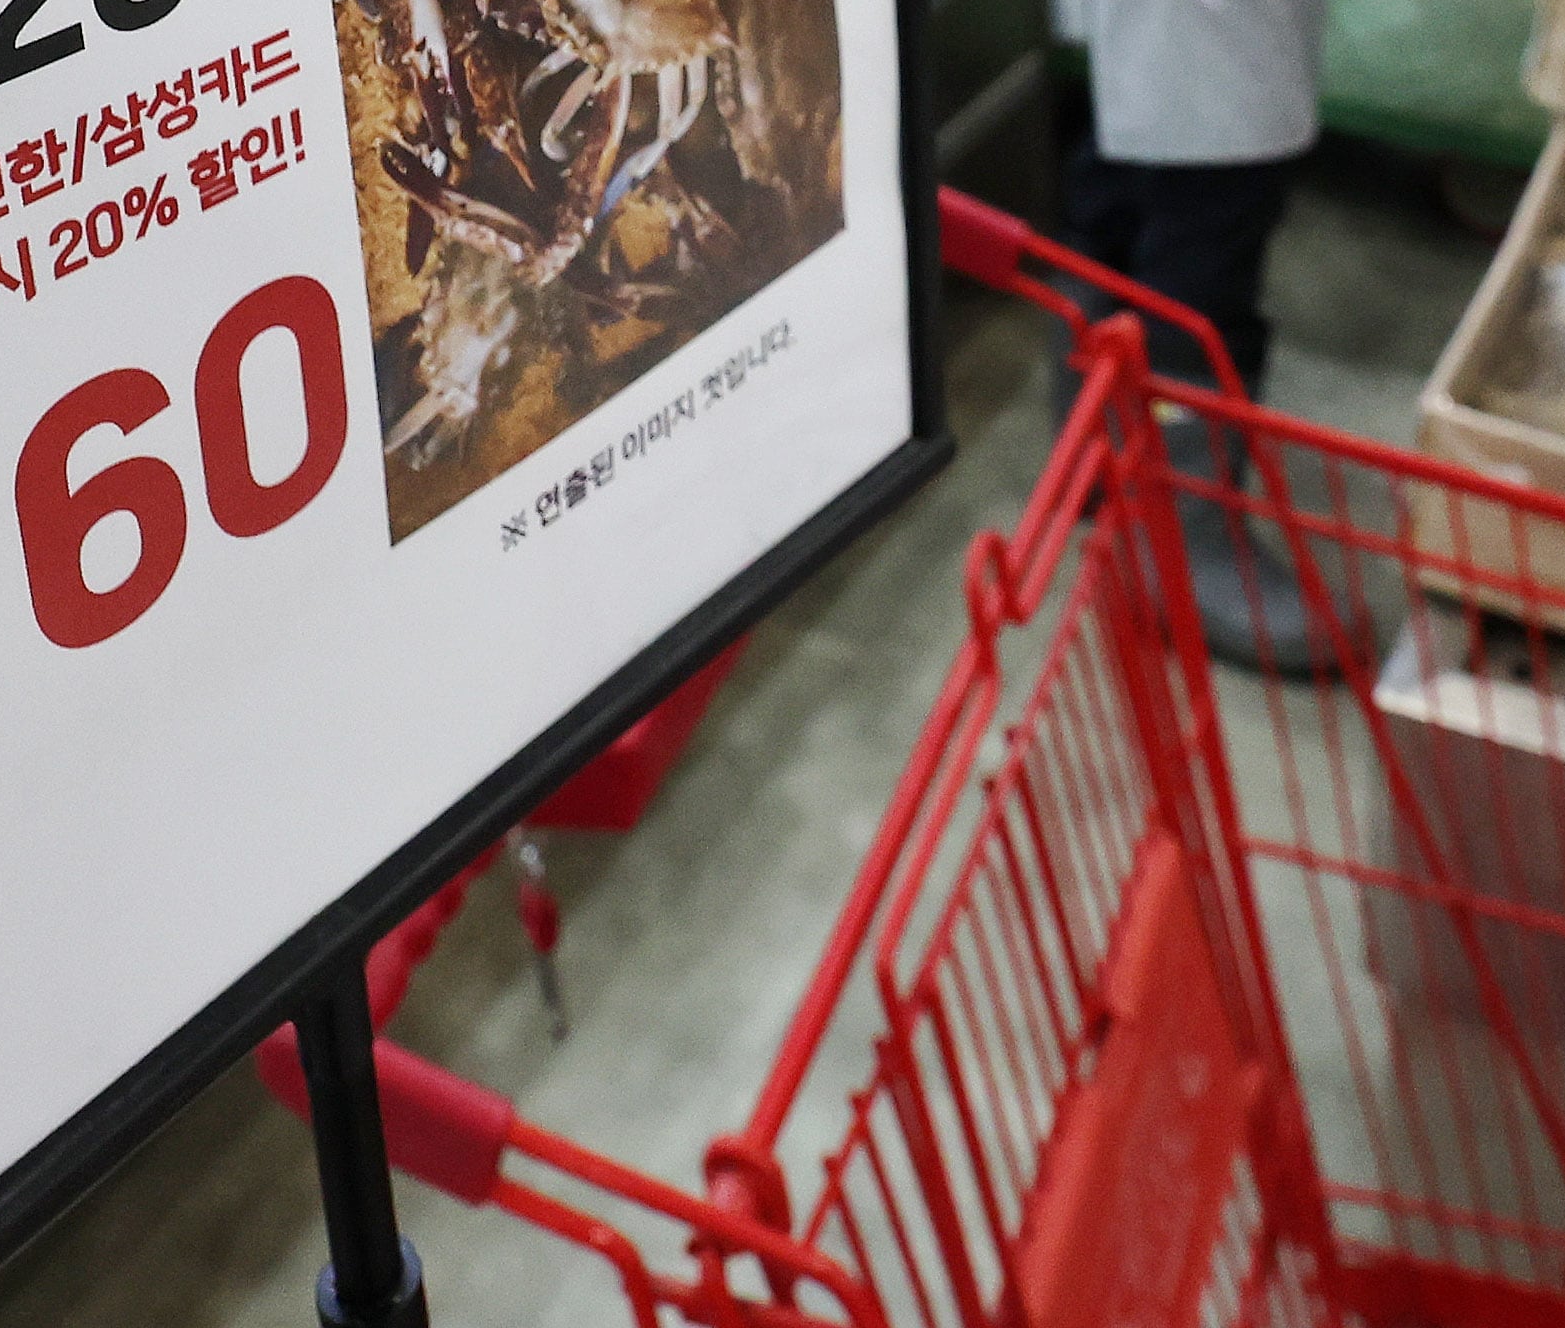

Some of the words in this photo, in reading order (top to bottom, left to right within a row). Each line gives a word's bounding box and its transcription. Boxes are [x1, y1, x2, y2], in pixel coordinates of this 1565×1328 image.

[52, 173, 180, 281] 20%
[188, 109, 308, 207] 할인!
[621, 389, 697, 461] 이미지
